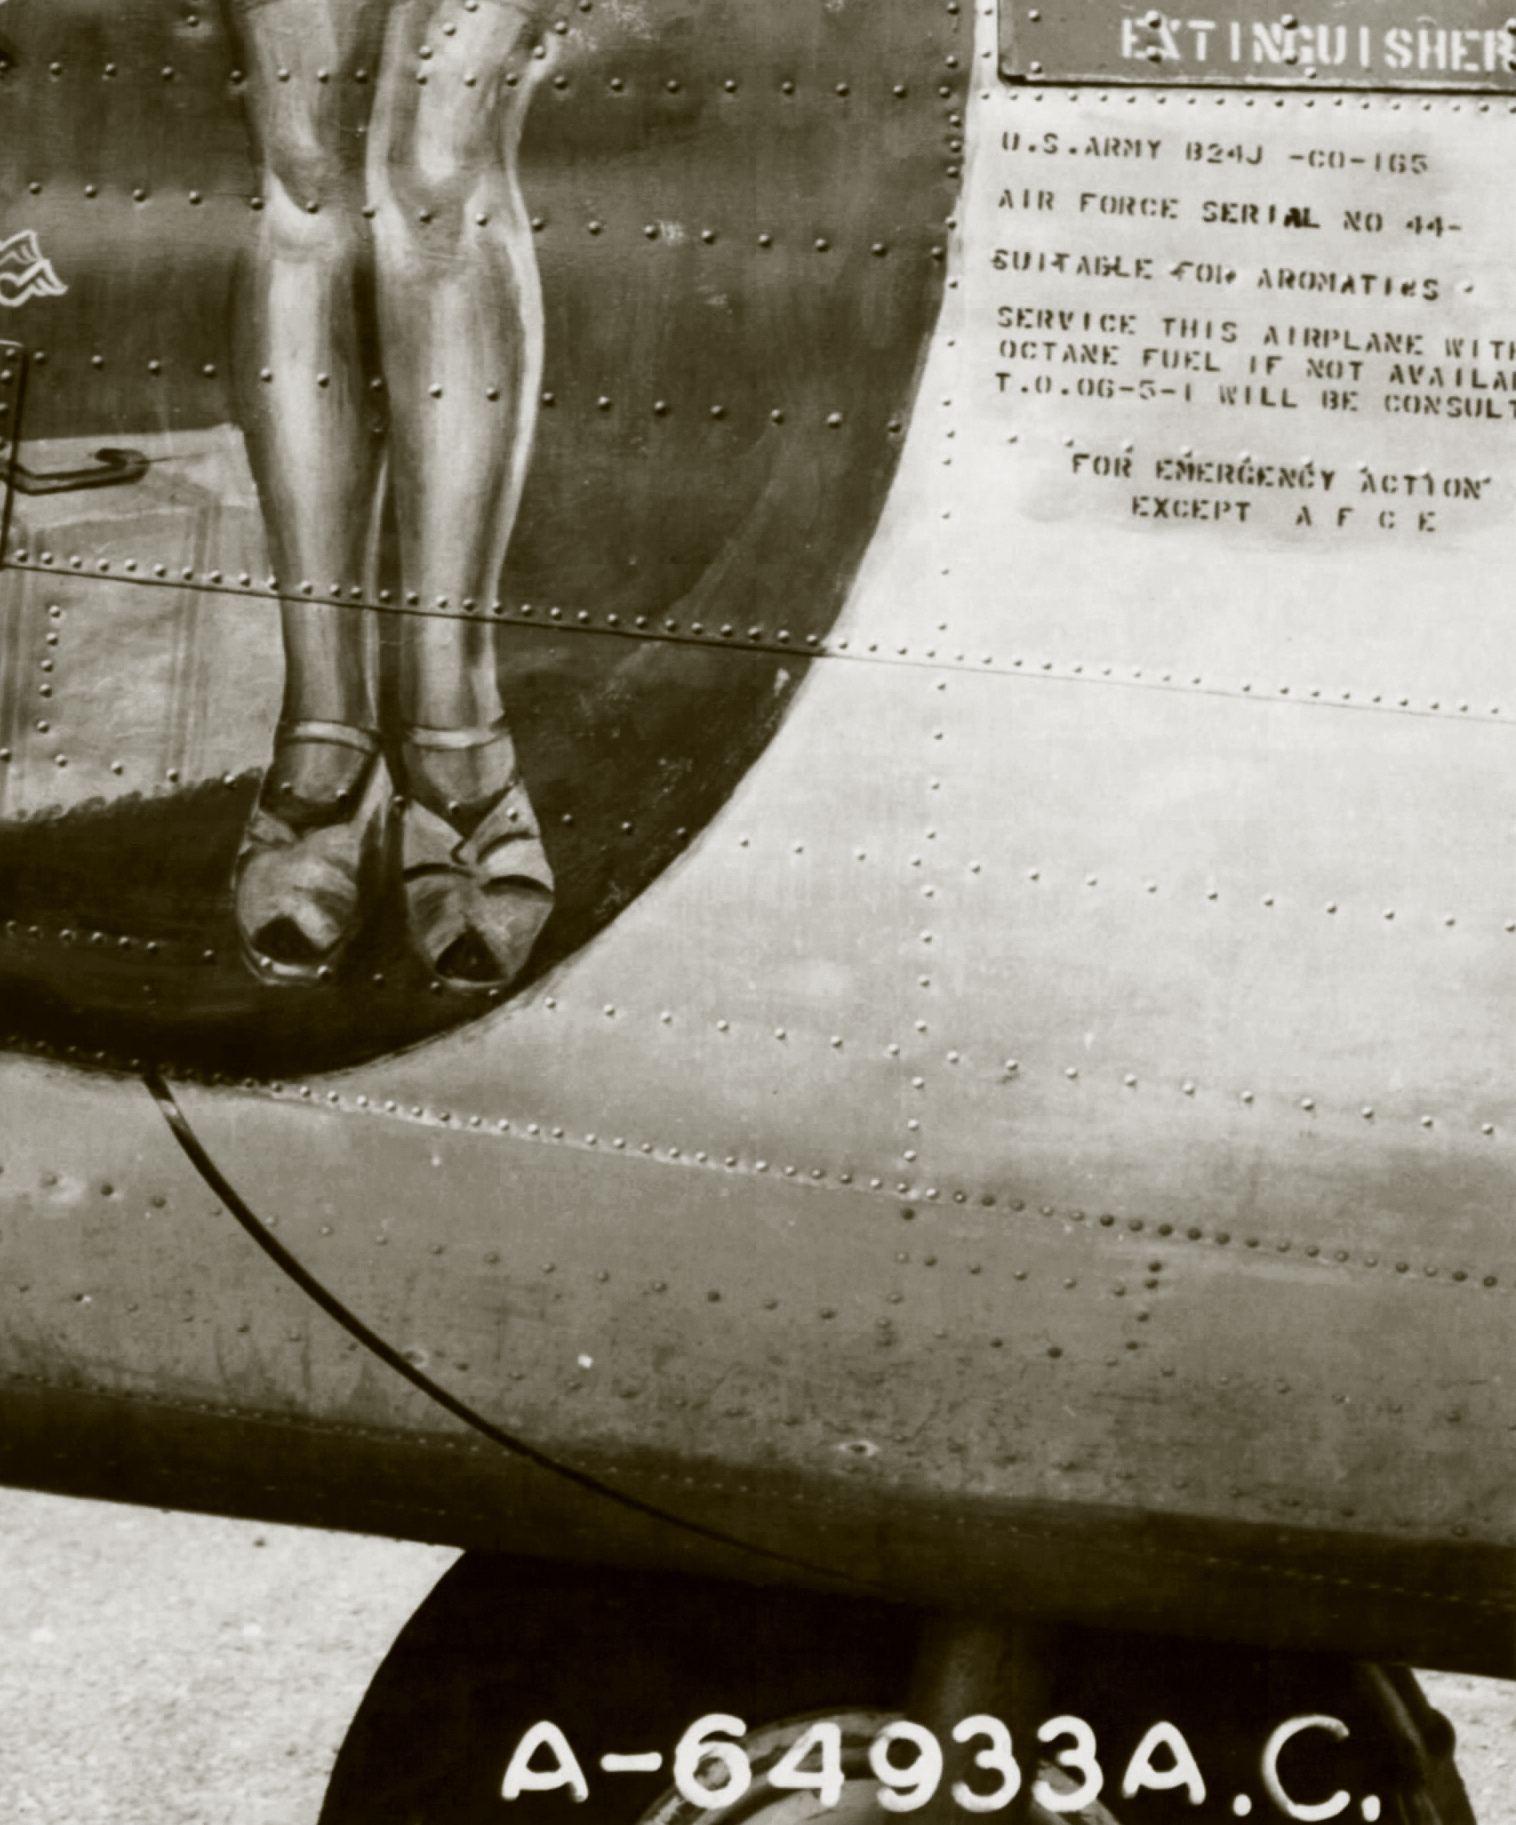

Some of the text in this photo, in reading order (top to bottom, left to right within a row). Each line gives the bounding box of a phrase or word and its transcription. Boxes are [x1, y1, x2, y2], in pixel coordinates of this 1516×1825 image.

[1120, 18, 1516, 73] EXTINGUISHER
[1185, 140, 1264, 166] B24J
[997, 187, 1056, 212] AIR
[1079, 190, 1181, 220] FORCE
[1201, 199, 1323, 230] SERIAL
[1342, 209, 1385, 234] NO
[991, 247, 1155, 281] SUITABLE
[997, 304, 1138, 336] SERVICE
[1161, 315, 1239, 345] THIS
[1262, 324, 1425, 358] AIRPLANE
[999, 338, 1121, 368] OCTANE
[1141, 346, 1222, 373] FUEL
[1249, 354, 1284, 377] IF
[1305, 357, 1366, 383] NOT
[1218, 384, 1299, 409] WILL
[1320, 389, 1360, 413] BE
[1071, 452, 1482, 501] FOR EMERGENCY ACTION
[1131, 495, 1252, 524] EXCEPT
